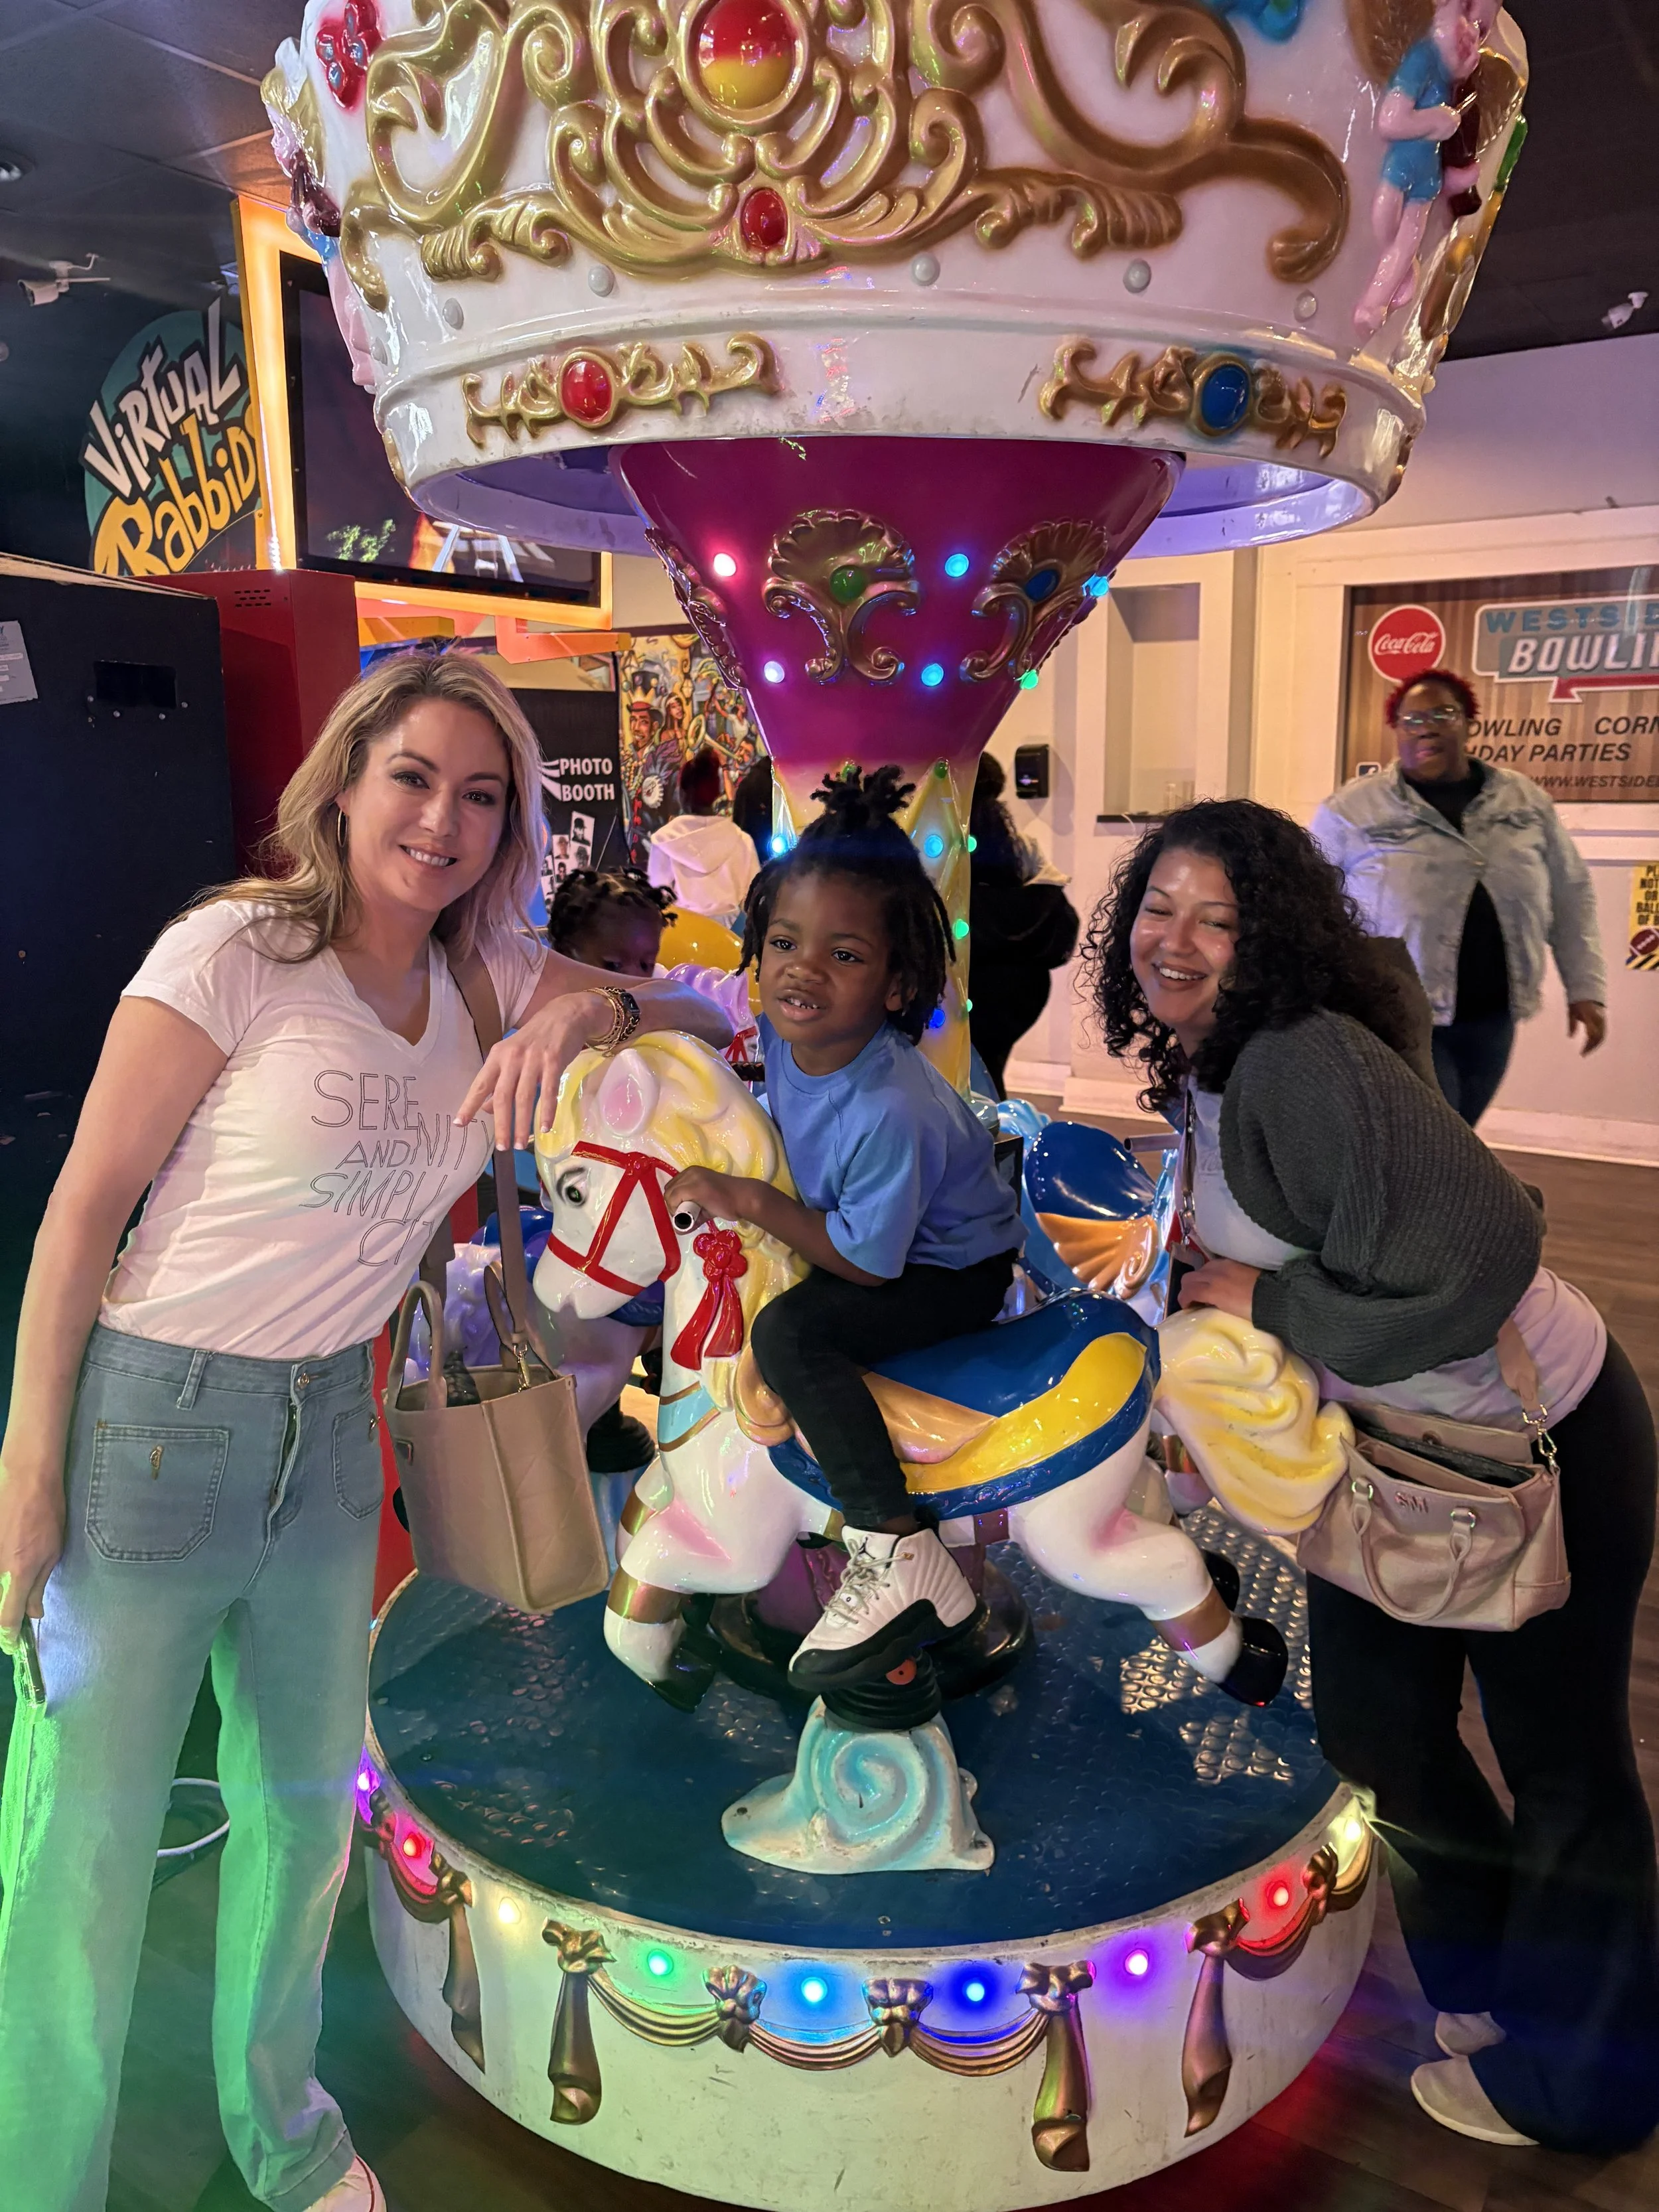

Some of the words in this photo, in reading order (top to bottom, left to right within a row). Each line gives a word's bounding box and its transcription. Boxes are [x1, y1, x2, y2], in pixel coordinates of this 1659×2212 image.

[1374, 632, 1439, 655] Coca-Cola
[1529, 743, 1632, 762] PARTIES
[559, 757, 613, 776] PHOTO
[561, 784, 615, 802] BOOTH
[311, 1070, 419, 1130] SERE
[335, 1140, 411, 1169] AND
